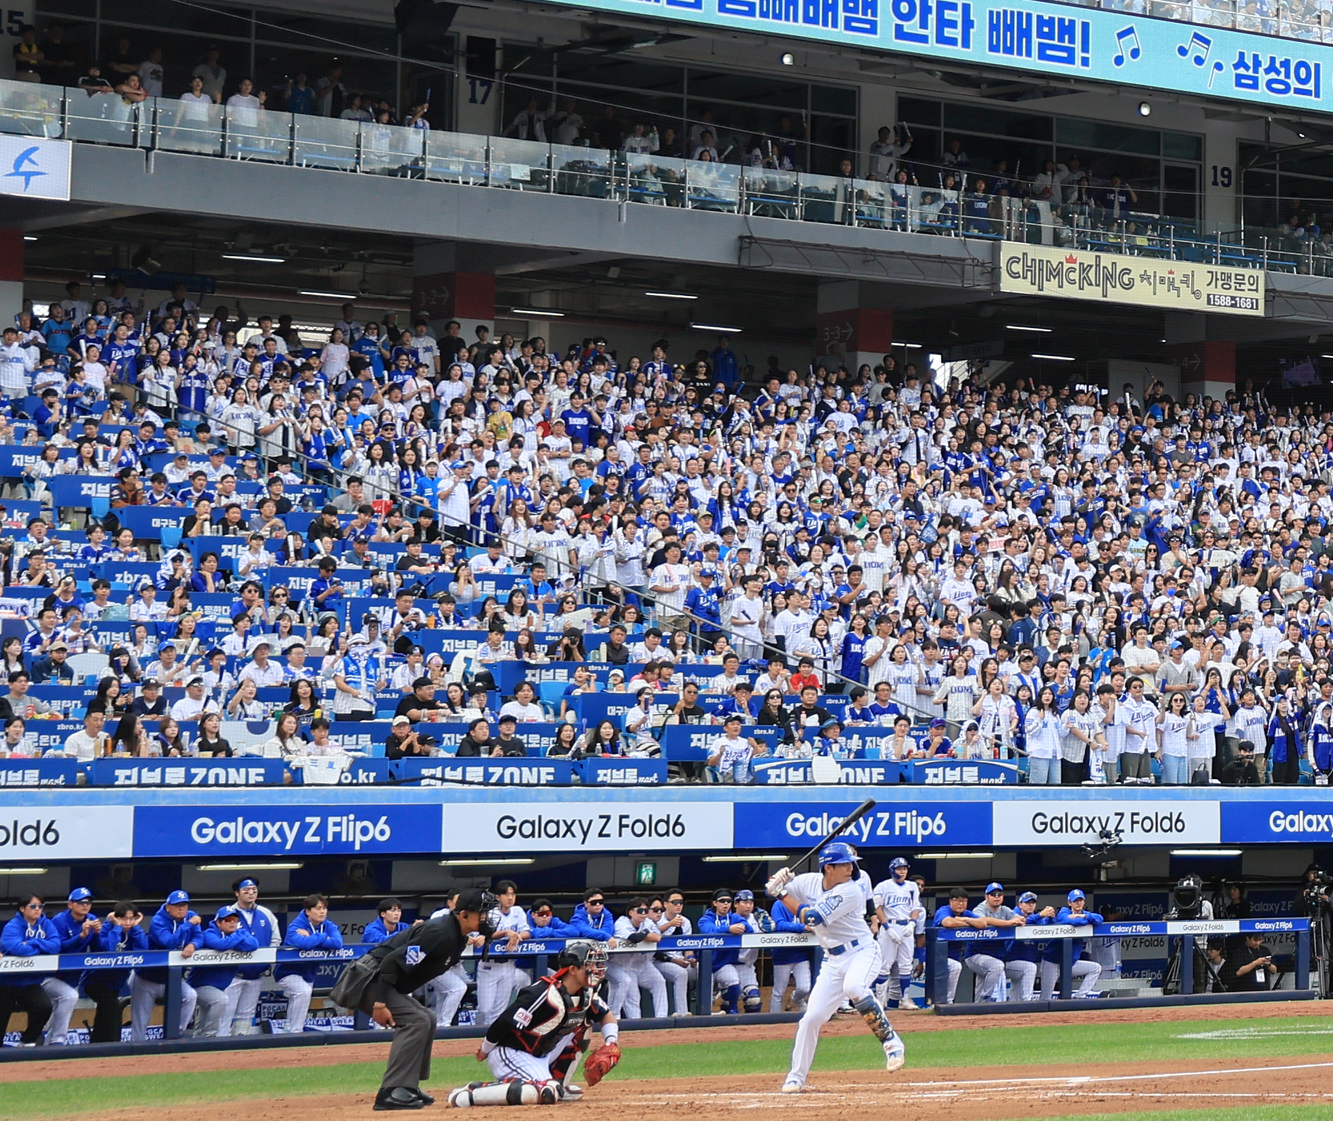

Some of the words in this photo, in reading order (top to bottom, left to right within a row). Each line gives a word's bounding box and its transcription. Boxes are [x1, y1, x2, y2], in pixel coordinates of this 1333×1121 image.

[988, 9, 1091, 68] 빼뱀!
[1232, 51, 1321, 99] 삼성의
[468, 79, 492, 105] 17
[1211, 165, 1232, 187] 19
[1206, 270, 1259, 294] 가맹문의
[1209, 294, 1257, 310] 1588-1681
[951, 686, 974, 694] LIONS
[0, 818, 60, 846] old6
[191, 816, 301, 850] Galaxy
[305, 817, 320, 843] Z
[327, 814, 391, 849] Flip6
[497, 816, 594, 846] Galaxy
[598, 816, 612, 838] Z
[618, 814, 686, 838] Fold6
[877, 813, 891, 836] Z
[894, 810, 946, 843] Flip6
[1031, 811, 1109, 843] Galaxy
[1115, 813, 1125, 833] Z
[1130, 810, 1186, 834] Fold6
[886, 895, 912, 907] Lions
[677, 938, 701, 948] Galaxy
[708, 937, 724, 948] Flip6
[760, 936, 785, 945] Galaxy
[793, 934, 809, 943] Fold6
[955, 930, 978, 940] Galaxy
[985, 929, 998, 939] Flip6
[11, 959, 35, 968] Fold6
[84, 957, 116, 967] Galaxy
[124, 955, 144, 965] Flip6
[193, 953, 221, 963] Galaxy
[229, 951, 253, 960] Fold6
